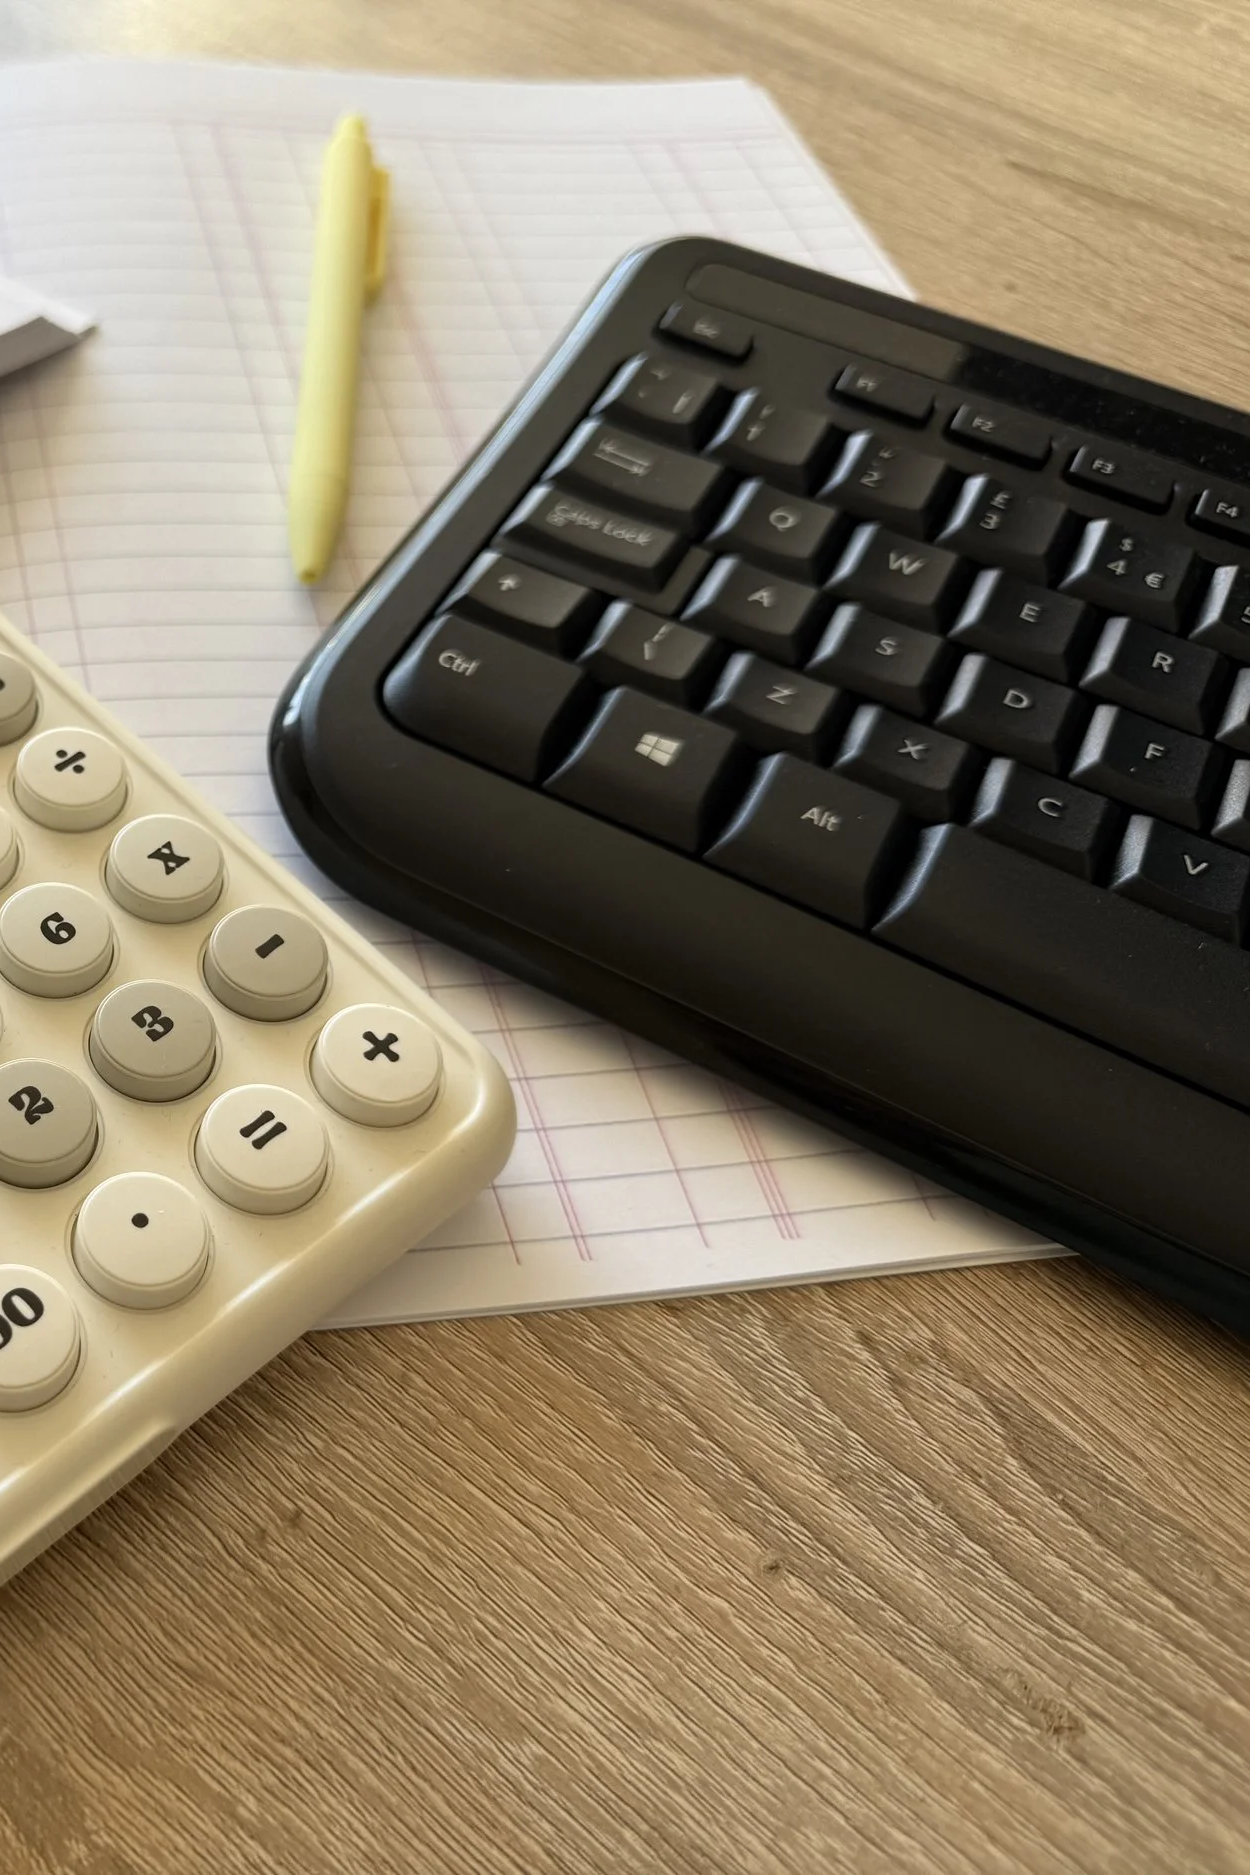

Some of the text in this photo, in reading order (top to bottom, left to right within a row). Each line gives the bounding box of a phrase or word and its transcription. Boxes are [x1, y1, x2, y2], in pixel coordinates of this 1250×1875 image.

[972, 415, 997, 433] F2
[1092, 457, 1116, 476] F3
[859, 470, 883, 487] 2
[769, 509, 798, 532] Q
[1216, 502, 1240, 519] F4
[979, 512, 1000, 530] 3
[1119, 537, 1134, 552] $
[888, 551, 925, 576] W
[1107, 559, 1127, 576] 4
[1144, 572, 1165, 589] €
[748, 586, 774, 608] A
[1019, 602, 1042, 622] E
[875, 637, 899, 657] S
[438, 648, 481, 676] Ctrl
[1152, 651, 1174, 673] R
[766, 684, 796, 706] Z
[1002, 689, 1033, 709] D
[898, 737, 929, 760] X
[1144, 743, 1165, 760] F
[1038, 797, 1065, 818] C
[800, 805, 842, 832] Alt
[1183, 855, 1208, 875] V
[40, 911, 77, 945] 6
[131, 1005, 175, 1042] 3
[7, 1085, 55, 1126] 2
